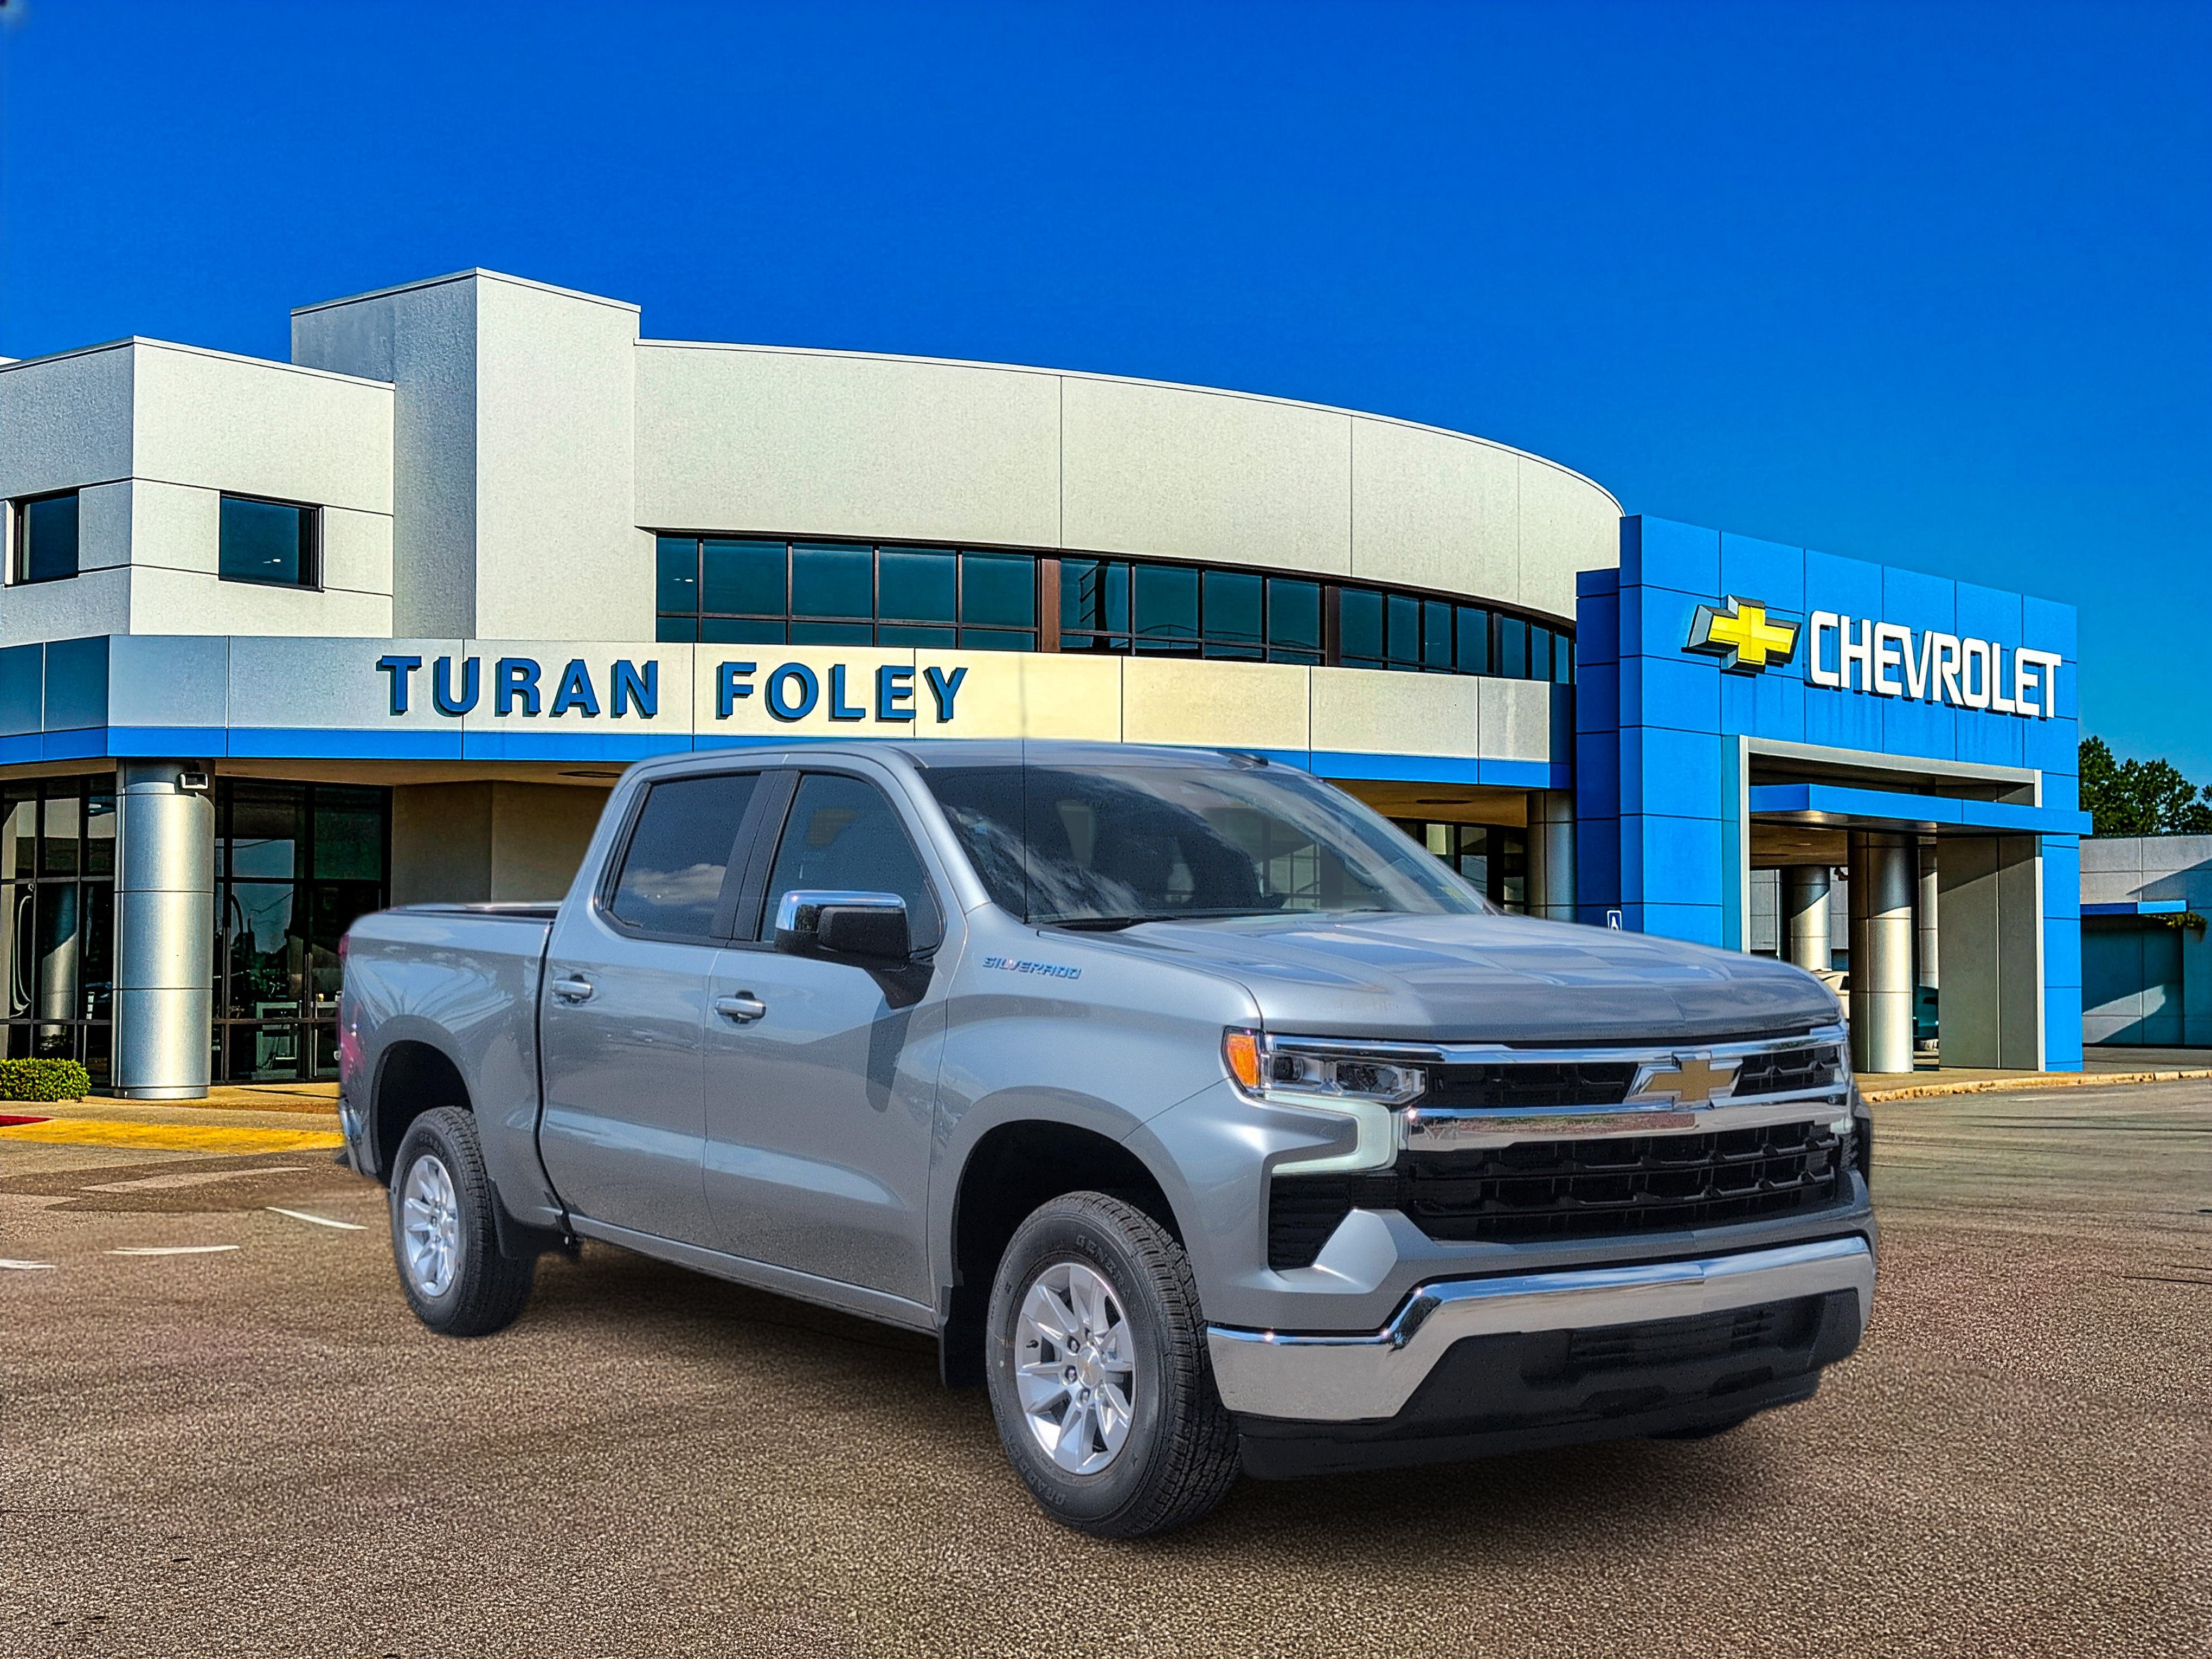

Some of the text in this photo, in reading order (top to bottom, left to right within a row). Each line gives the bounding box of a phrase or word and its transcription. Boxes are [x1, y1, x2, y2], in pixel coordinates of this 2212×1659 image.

[377, 655, 968, 723] TURAN FOLEY
[1810, 610, 2062, 718] CHEVROLET
[982, 957, 1082, 980] SILVERADO
